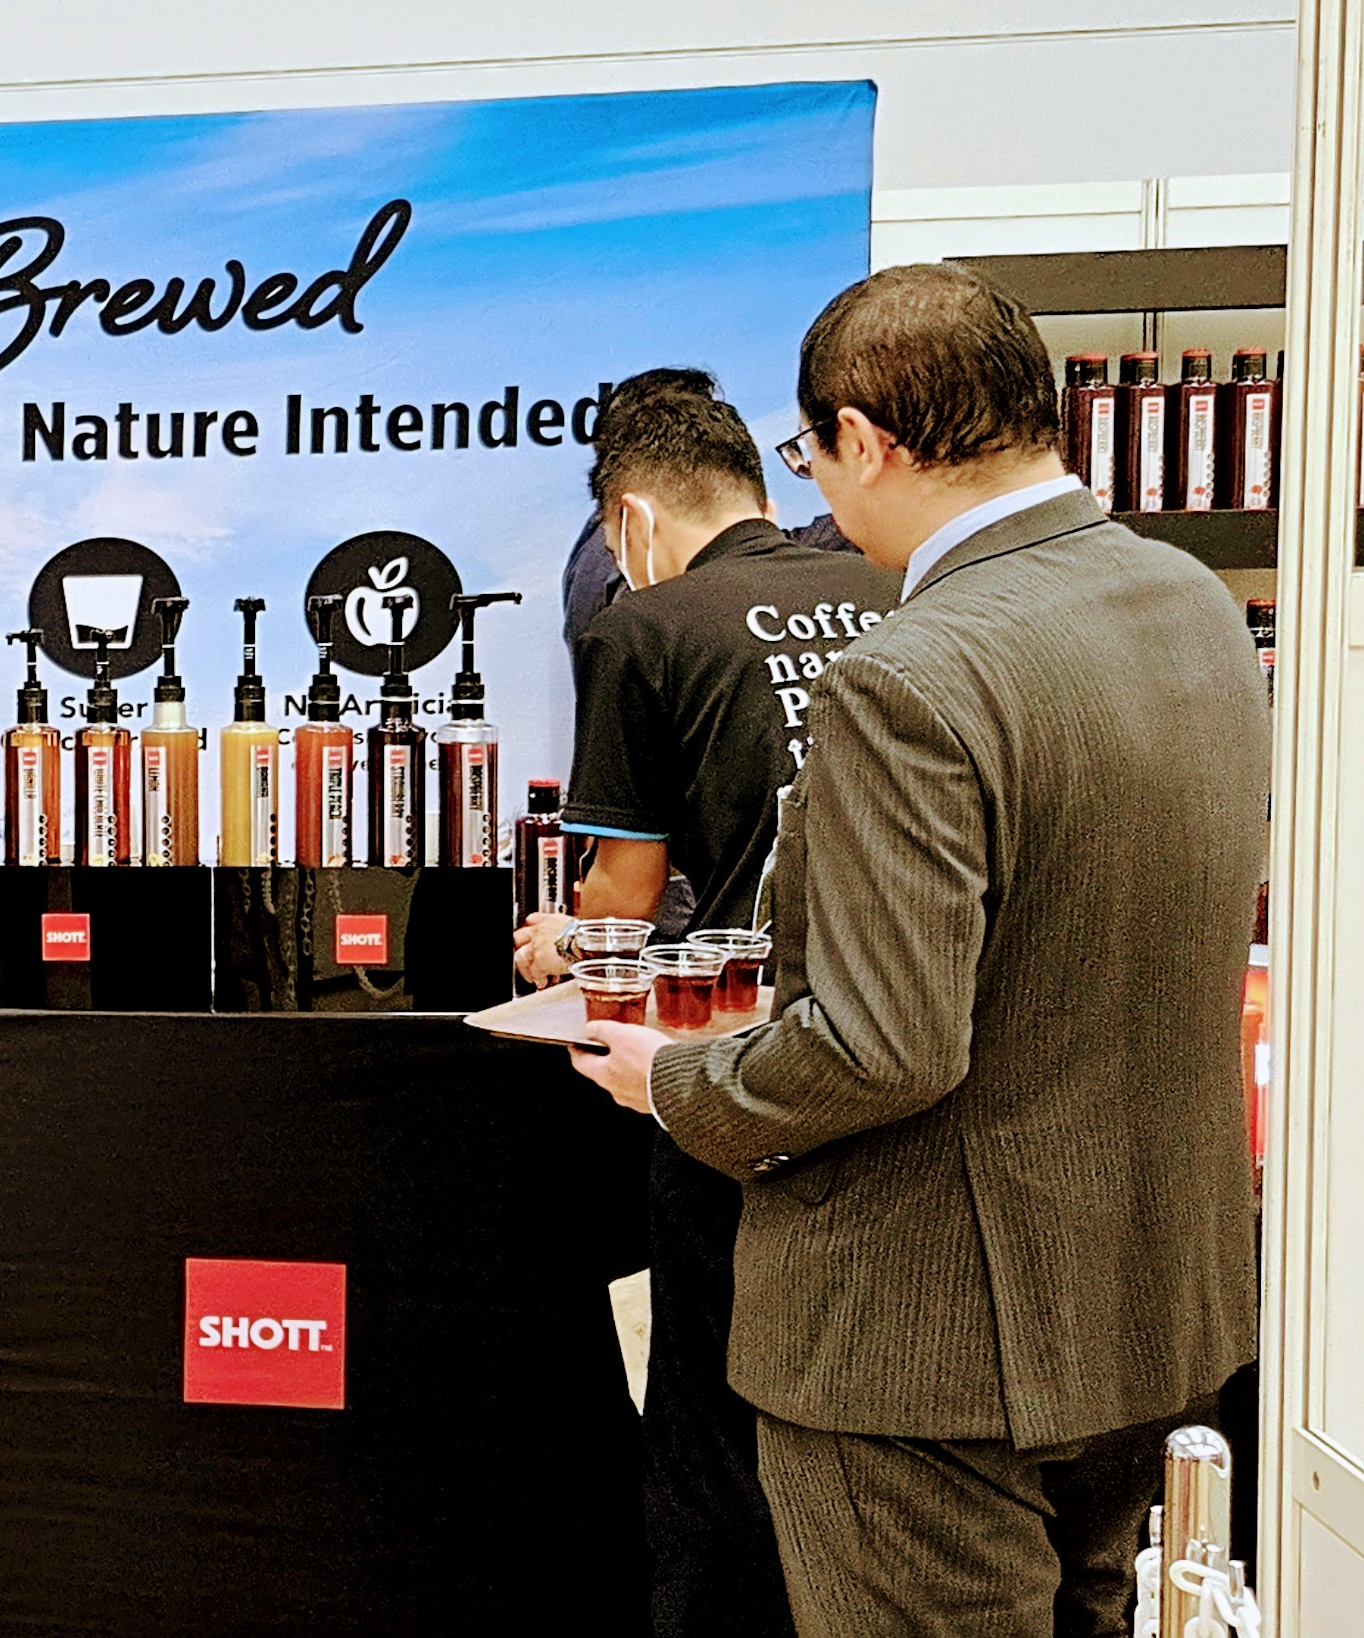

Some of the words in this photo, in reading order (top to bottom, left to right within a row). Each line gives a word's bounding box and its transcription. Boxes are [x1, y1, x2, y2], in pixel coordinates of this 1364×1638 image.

[23, 401, 260, 462] Nature
[285, 382, 613, 455] Intended
[745, 602, 896, 642] Coffe
[60, 696, 149, 719] Suer
[198, 1315, 328, 1352] SHOTT
